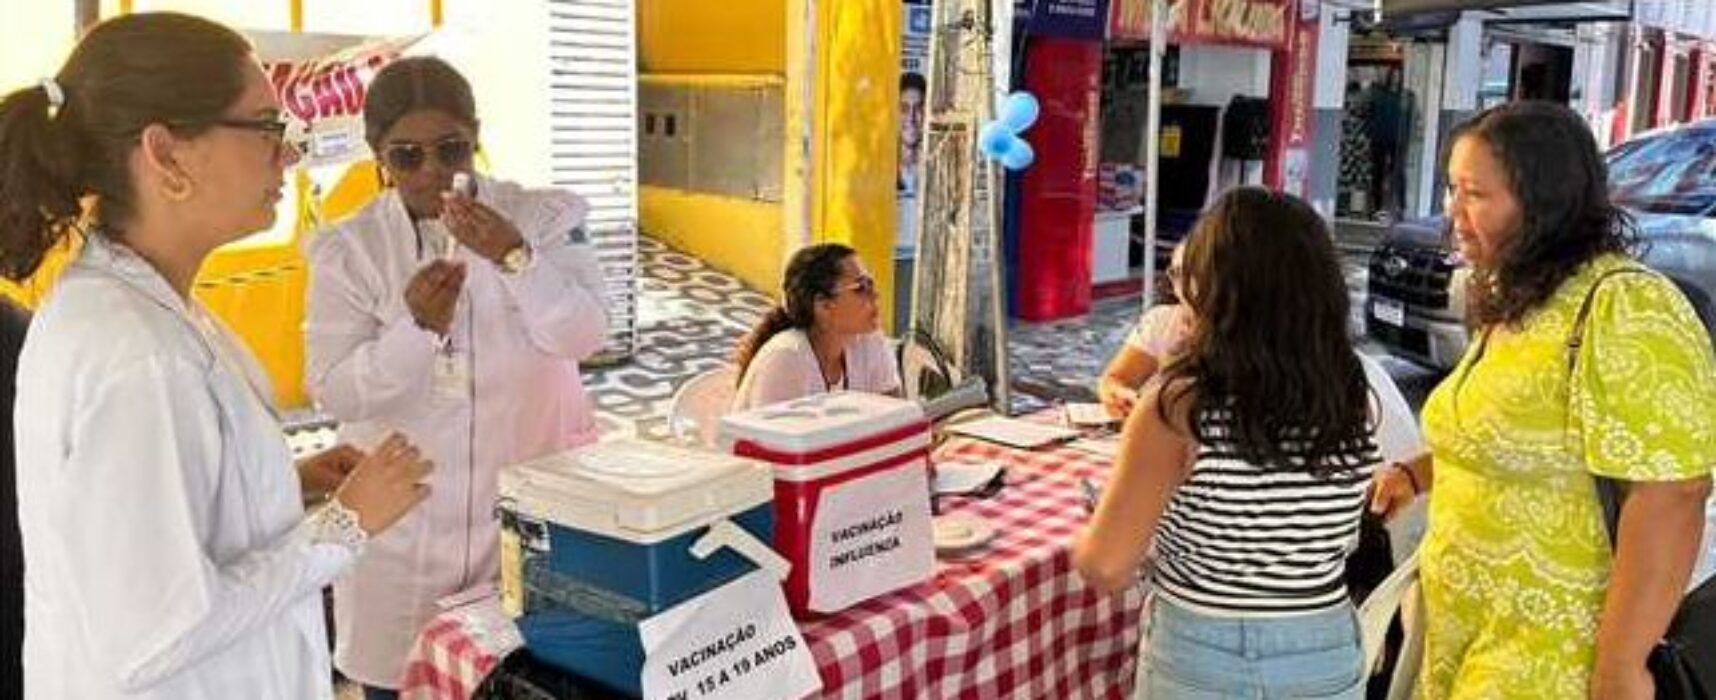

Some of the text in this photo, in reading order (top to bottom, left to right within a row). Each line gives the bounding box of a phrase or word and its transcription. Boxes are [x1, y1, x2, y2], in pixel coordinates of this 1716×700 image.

[831, 510, 903, 543] VACINAÇÃO
[829, 536, 901, 568] INFLUENZA
[667, 624, 756, 677] VACINAÇÃO
[696, 675, 716, 695] 15
[733, 657, 751, 677] 19
[755, 635, 796, 667] ANOS
